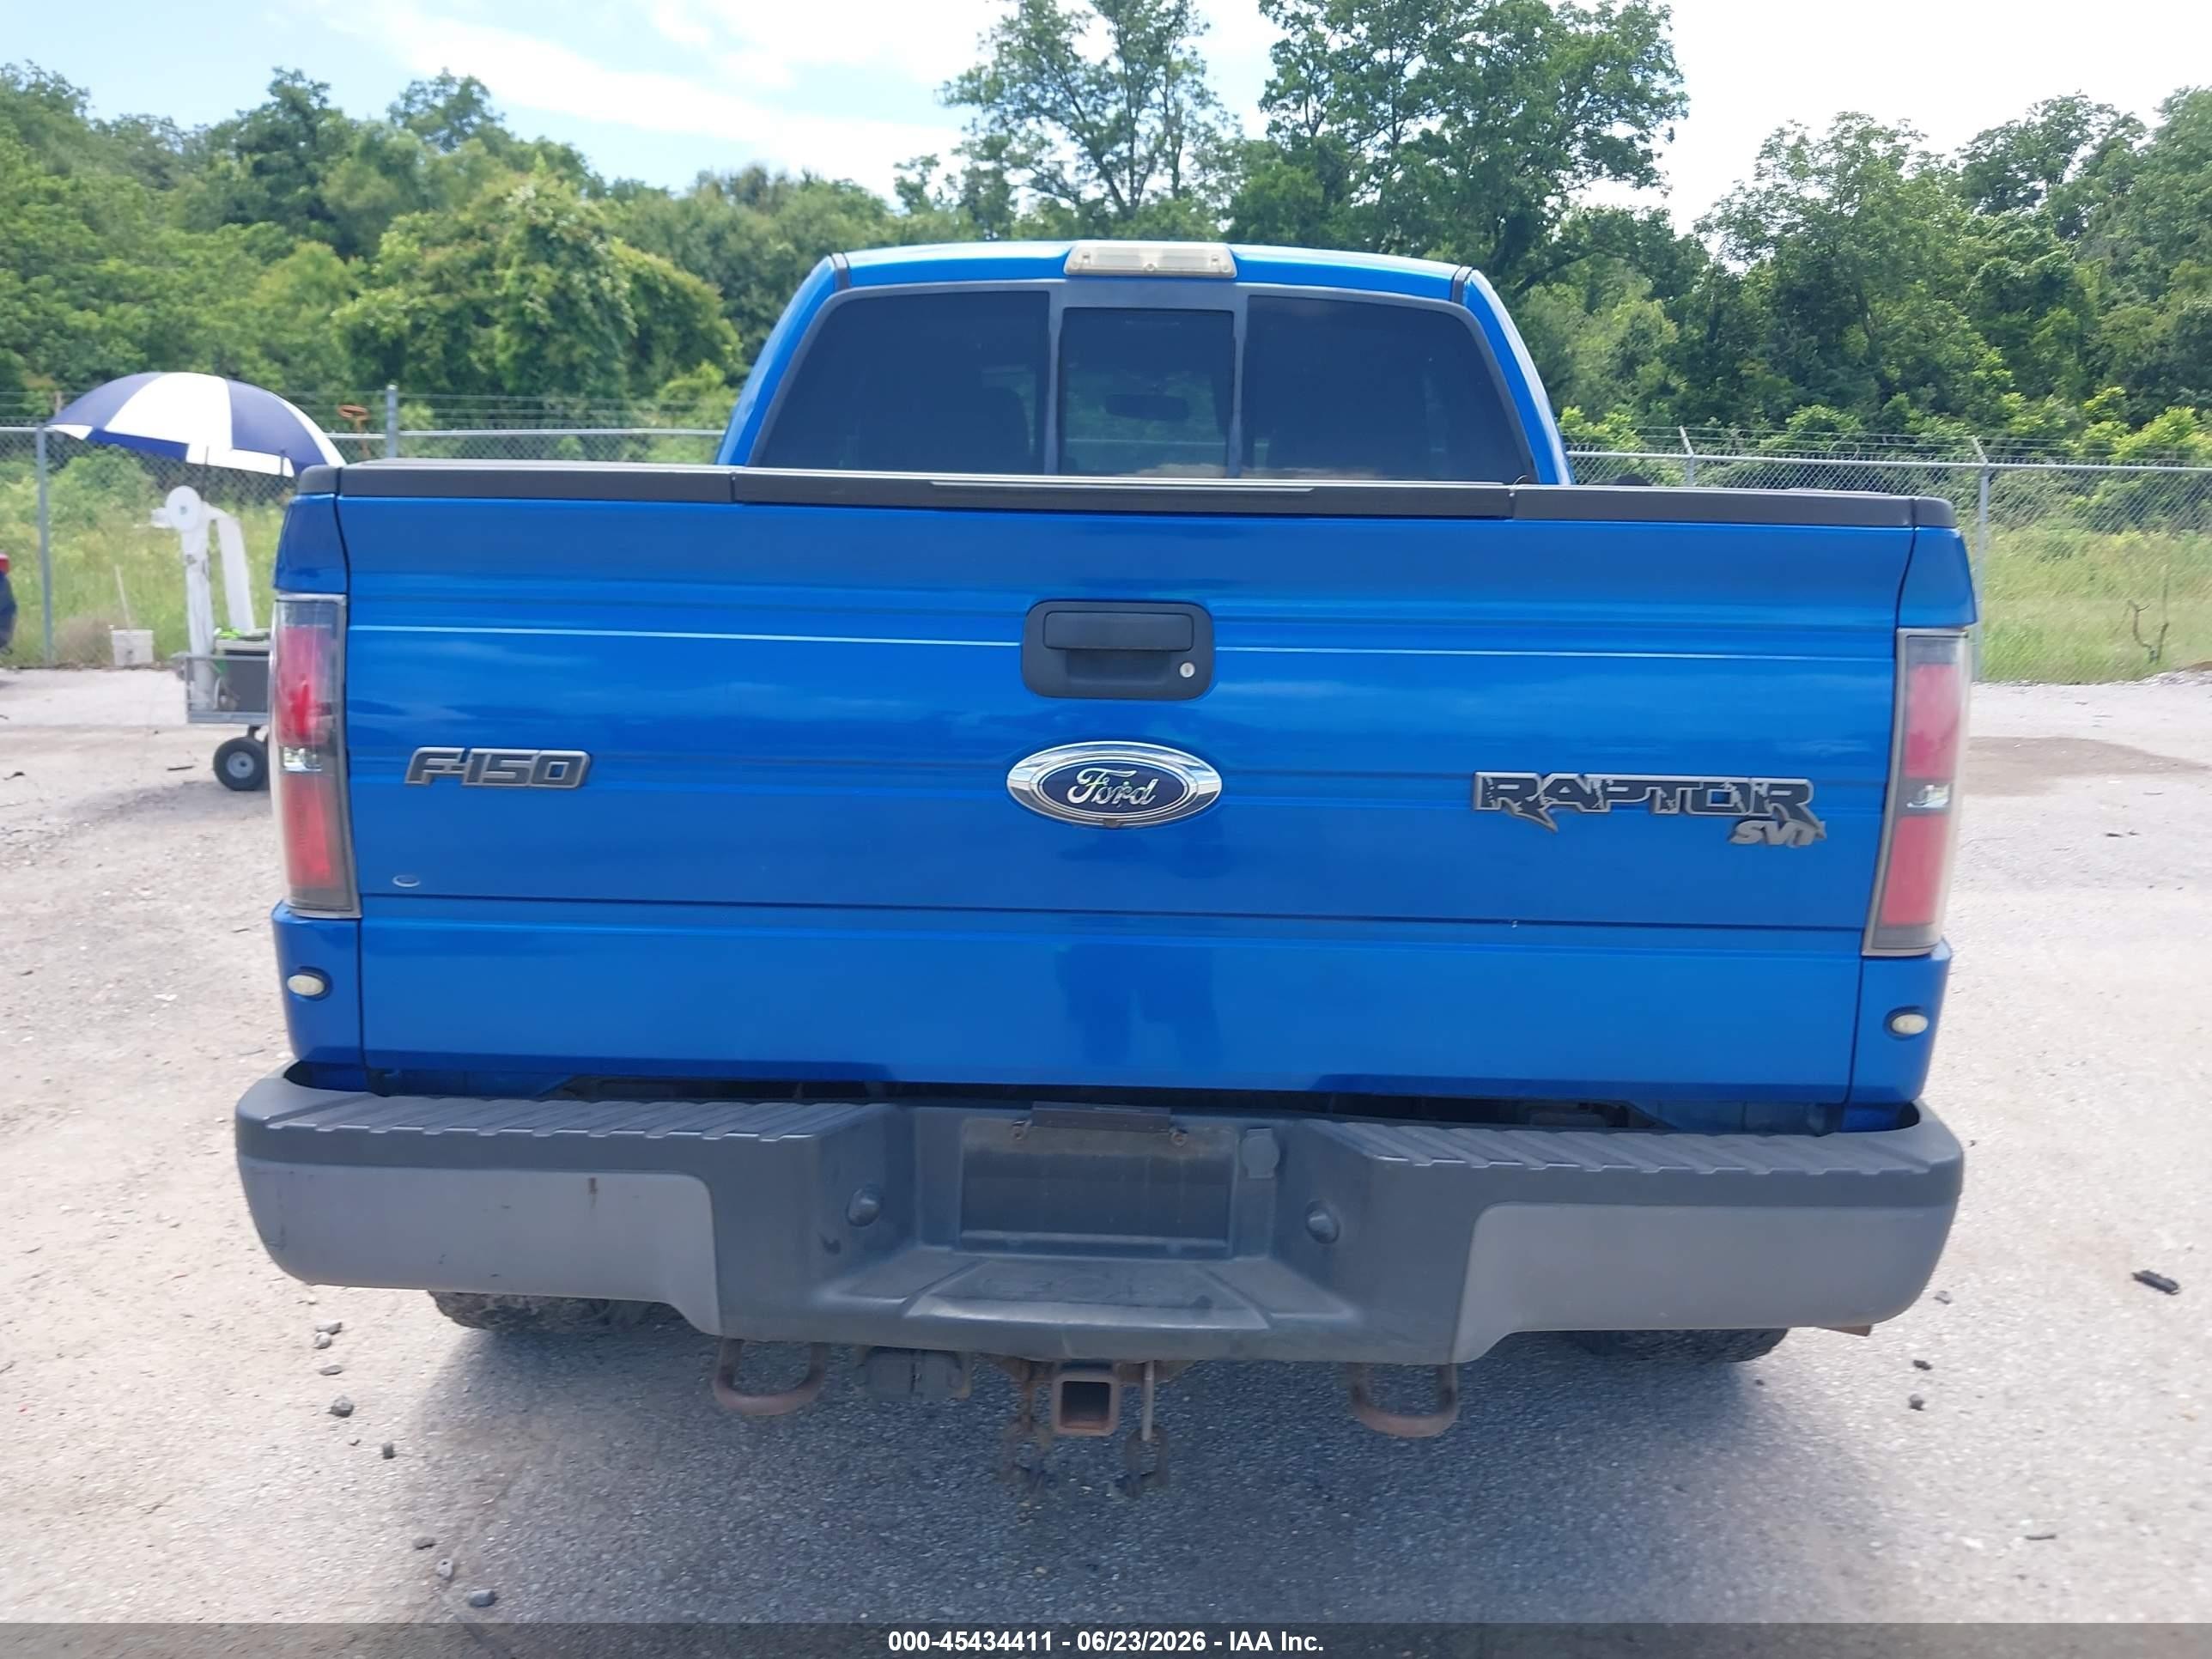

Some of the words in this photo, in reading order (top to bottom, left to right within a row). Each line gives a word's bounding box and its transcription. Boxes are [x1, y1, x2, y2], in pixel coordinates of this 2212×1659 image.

[404, 746, 591, 788] F-150
[1067, 767, 1159, 805] Ford
[1474, 771, 1814, 831] RAPTOR
[1729, 818, 1826, 848] SVT
